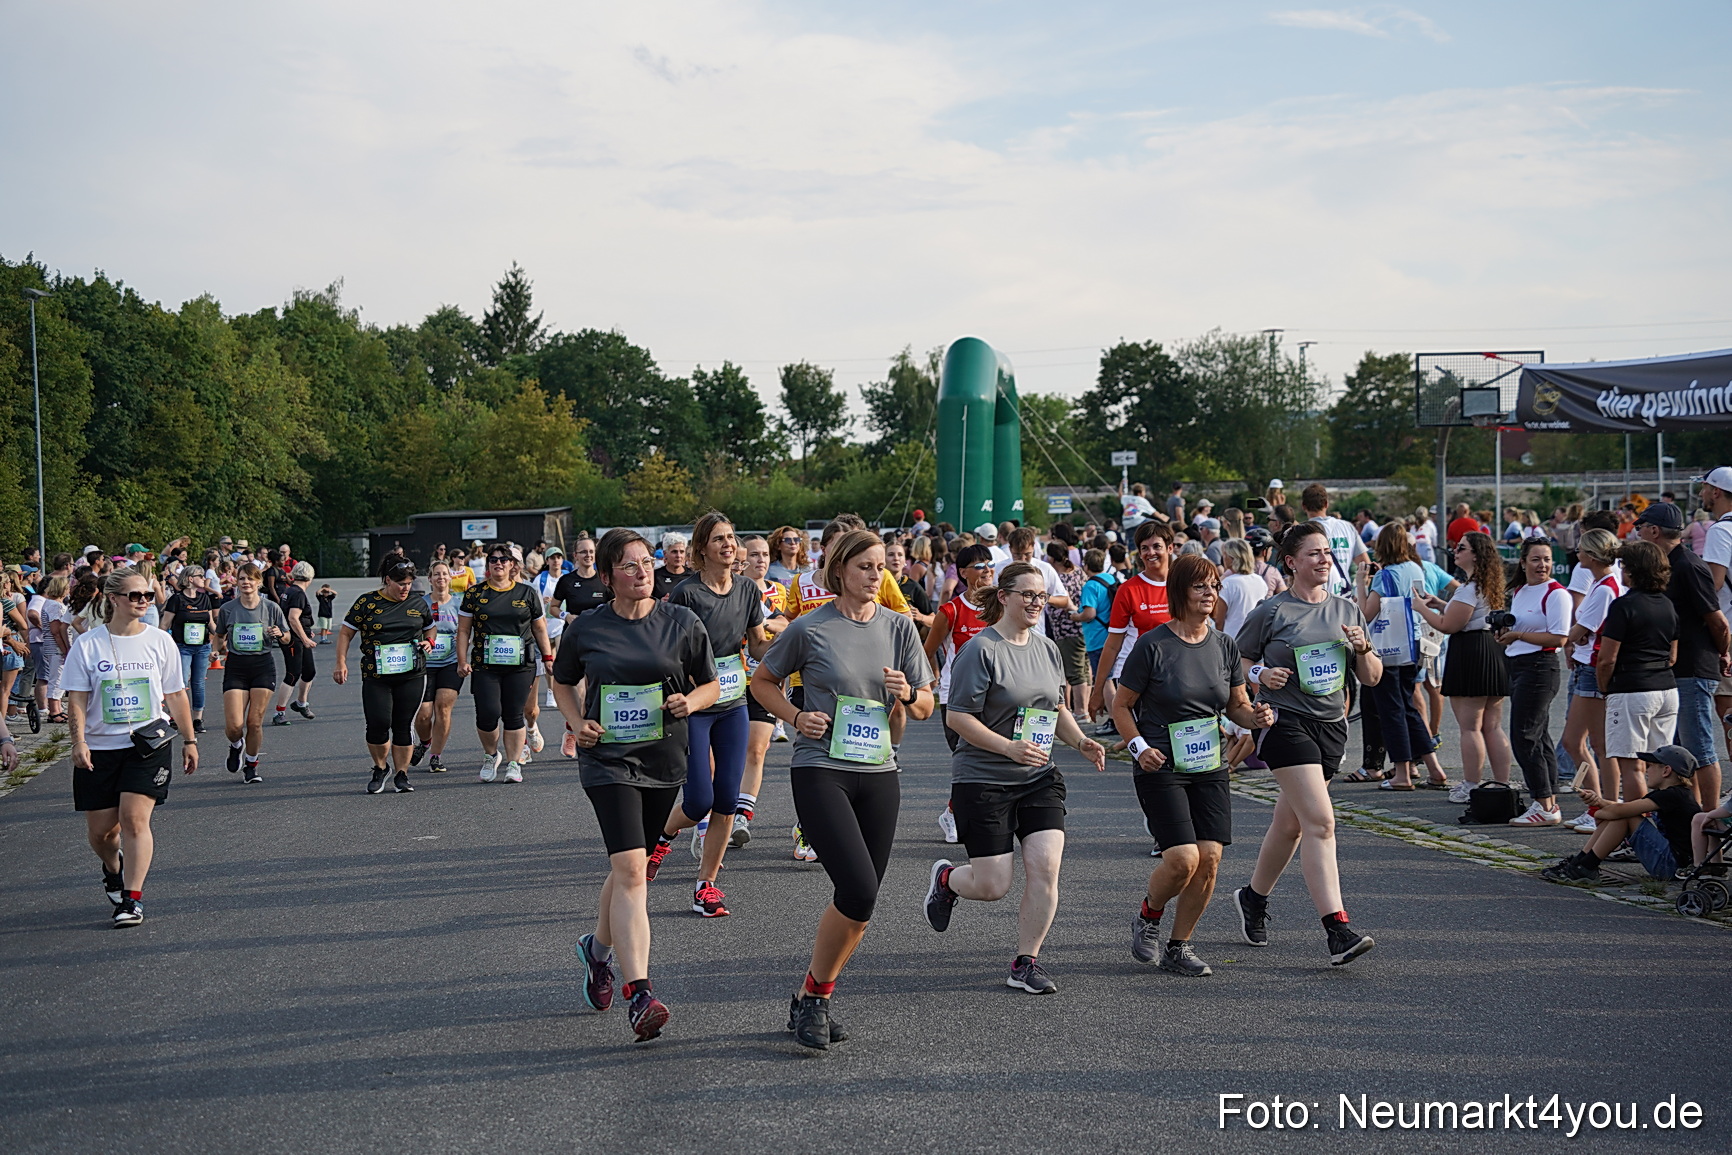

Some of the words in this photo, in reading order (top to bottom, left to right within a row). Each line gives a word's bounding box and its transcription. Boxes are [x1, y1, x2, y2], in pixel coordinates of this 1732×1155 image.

[1597, 386, 1640, 418] Hier
[802, 602, 823, 612] MAX
[1382, 646, 1401, 654] BANK
[115, 662, 155, 671] GEITNER
[1309, 662, 1338, 678] 1945
[1306, 678, 1328, 686] Christina
[111, 696, 139, 707] 1009
[613, 708, 649, 722] 1929
[847, 723, 880, 740] 1936
[842, 738, 863, 747] Sabrina
[1185, 740, 1211, 755] 1941
